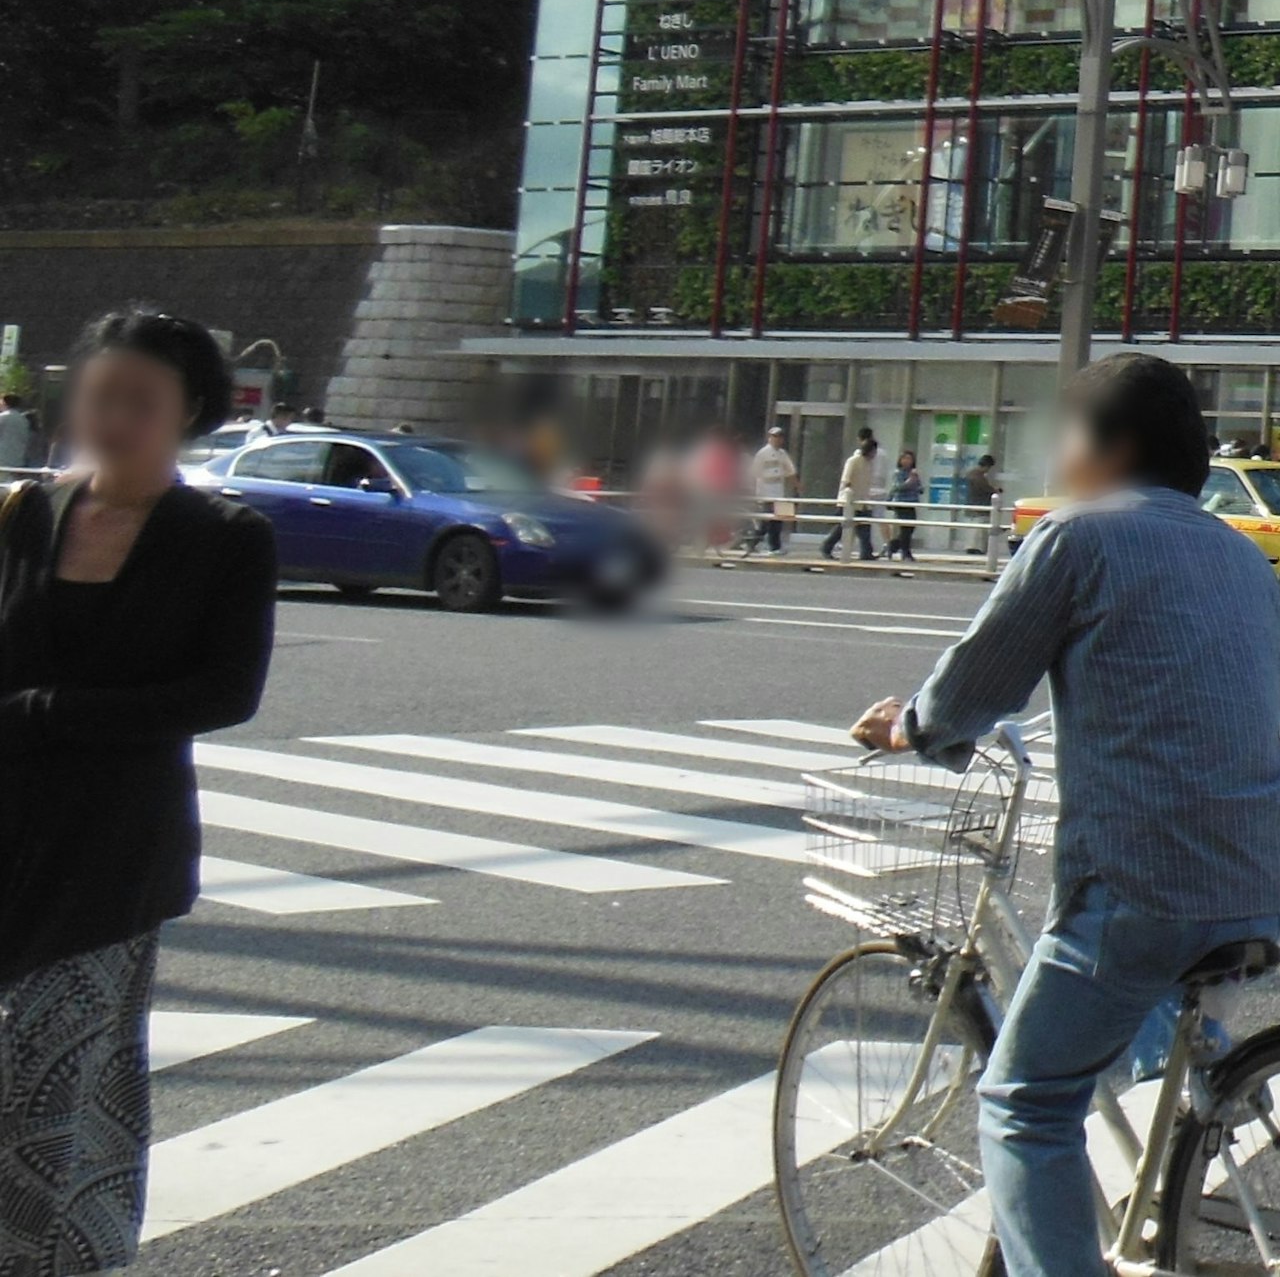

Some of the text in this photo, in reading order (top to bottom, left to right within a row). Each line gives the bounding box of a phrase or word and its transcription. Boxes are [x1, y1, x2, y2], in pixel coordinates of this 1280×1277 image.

[660, 43, 699, 60] UENO
[632, 75, 709, 94] Family Mart
